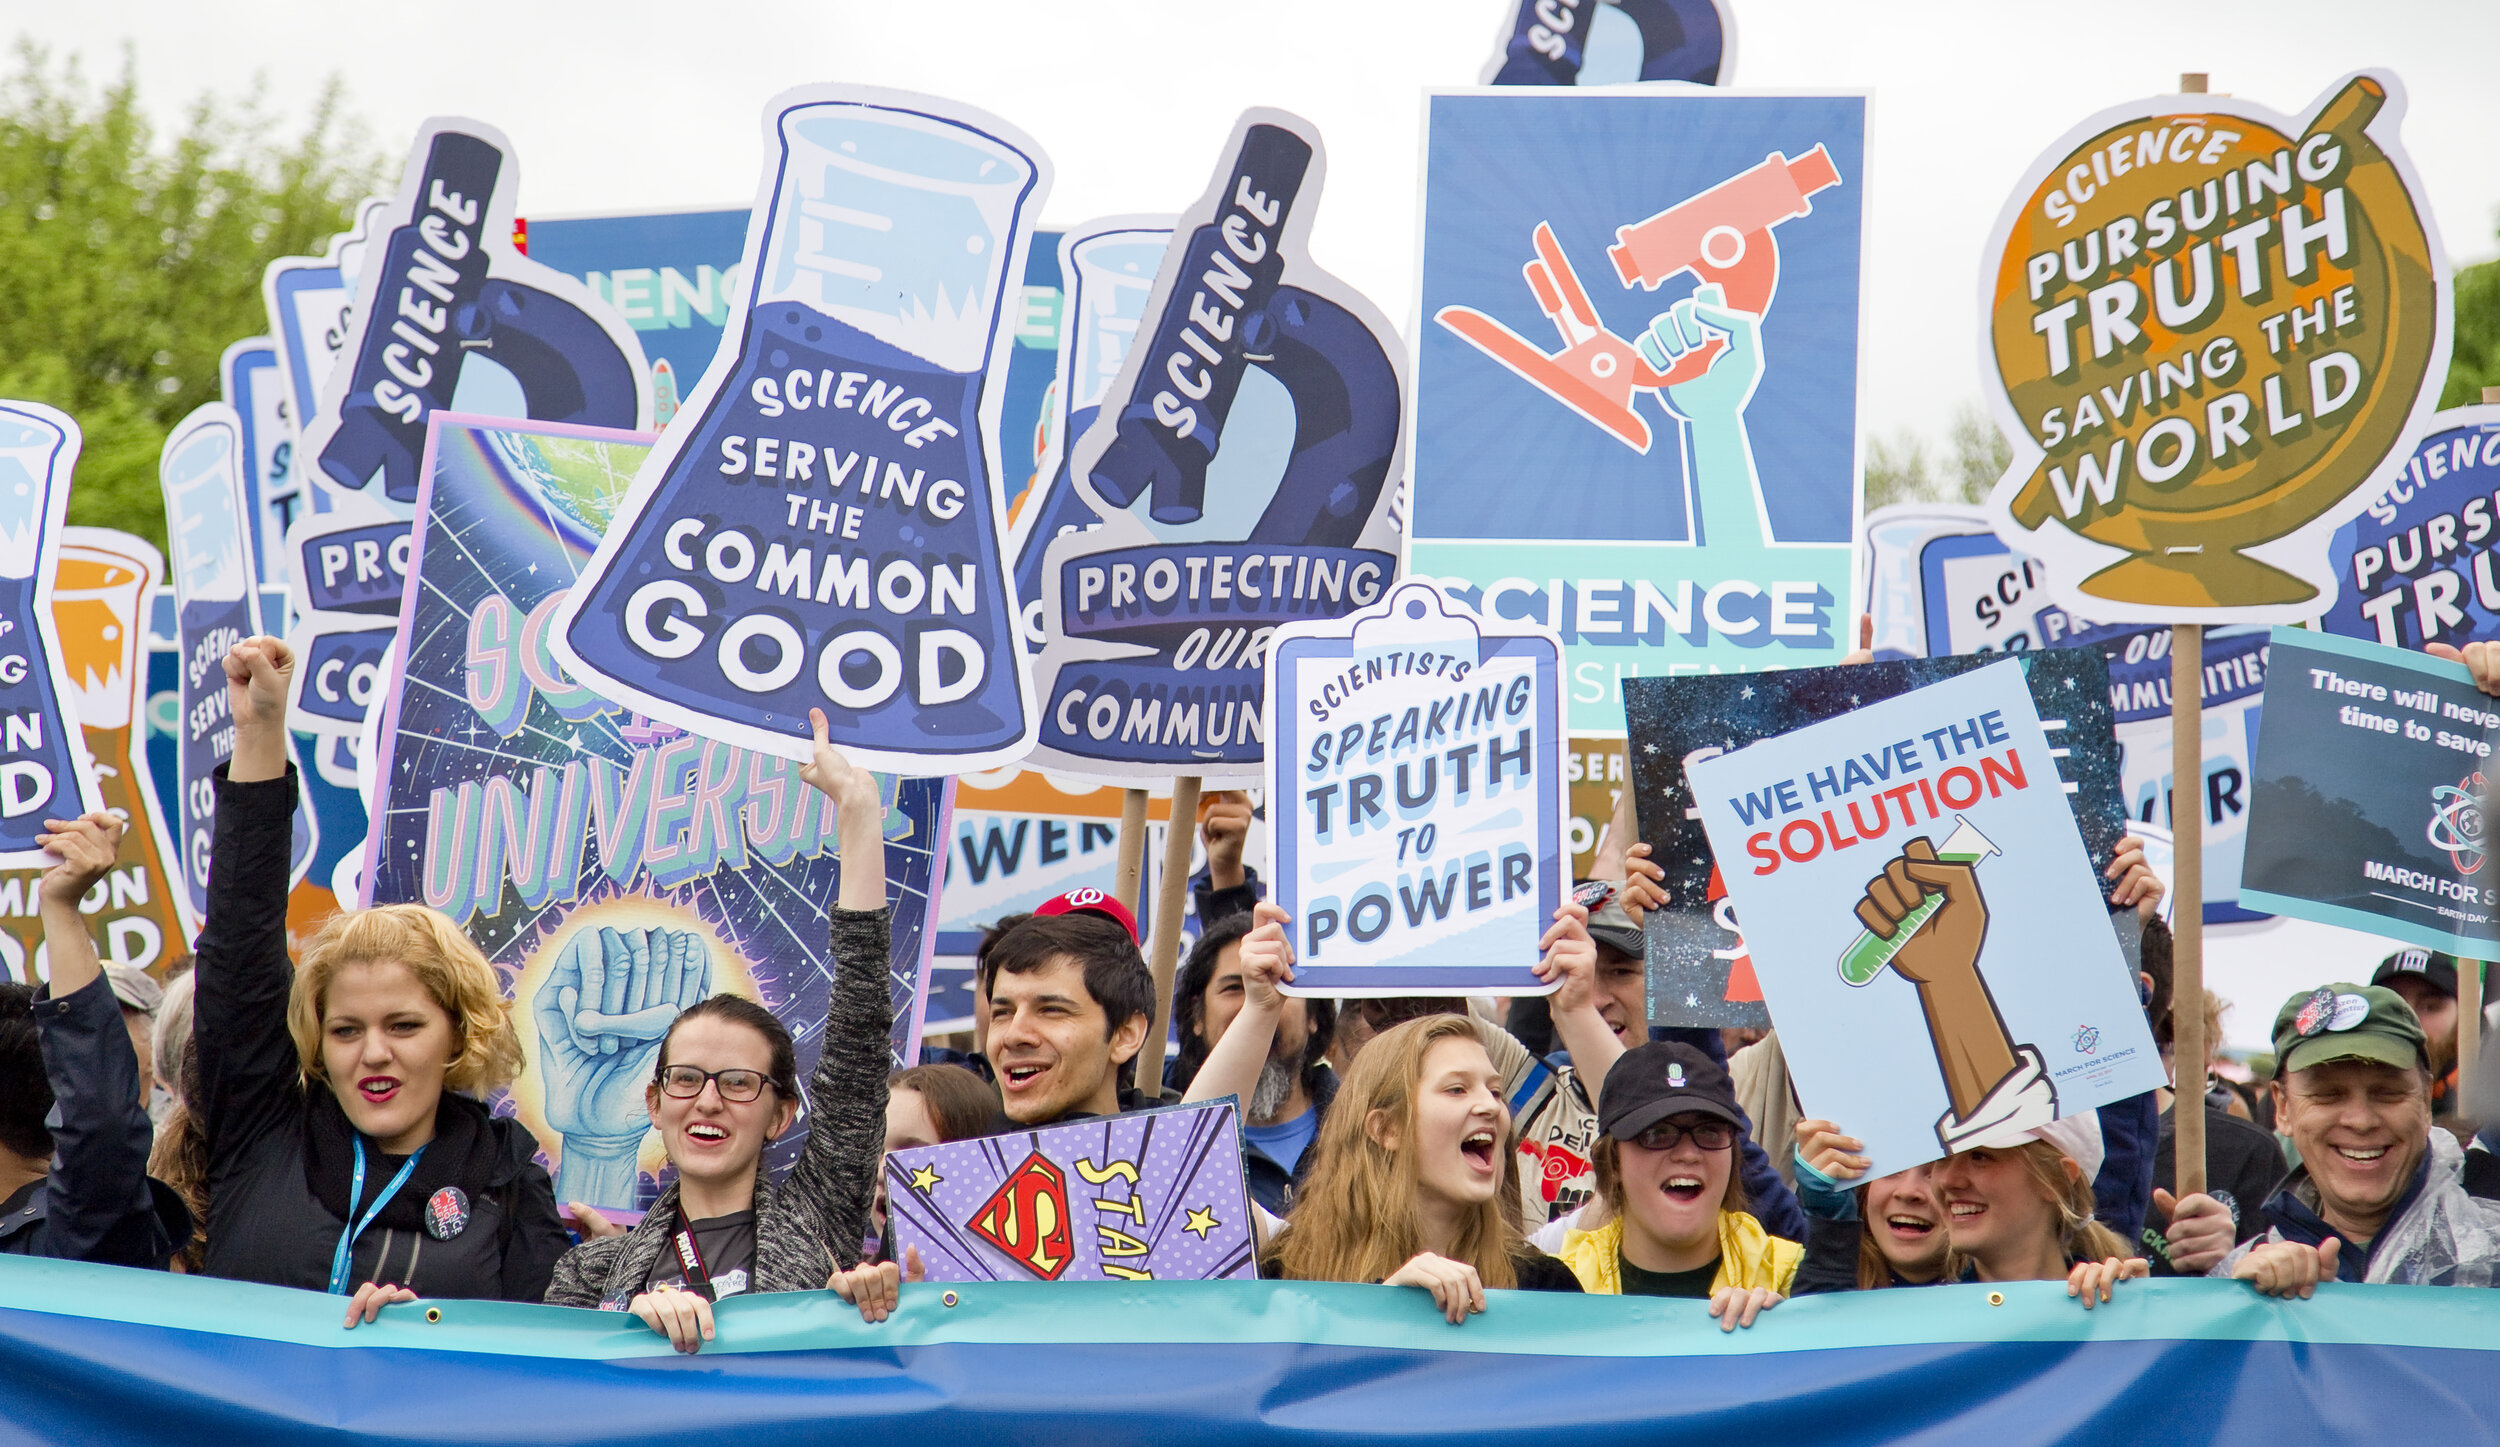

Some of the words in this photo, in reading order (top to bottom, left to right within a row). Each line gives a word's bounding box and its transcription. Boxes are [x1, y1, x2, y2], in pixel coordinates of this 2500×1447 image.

[2027, 132, 2342, 302] PURSUING
[2043, 125, 2242, 228] SCIENCE
[372, 178, 478, 425] SCIENCE
[1153, 175, 1280, 439] SCIENCE
[2033, 187, 2350, 378] TRUTH
[2040, 336, 2238, 448] SAVING
[2260, 285, 2357, 355] THE
[750, 368, 958, 449] SCIENCE
[2047, 350, 2361, 520] WORLD
[719, 435, 966, 520] SERVING
[785, 493, 864, 541] THE
[663, 517, 977, 616] COMMON
[1078, 554, 1383, 613] PROTECTING
[625, 579, 985, 709] GOOD
[1307, 676, 1532, 774] SPEAKING
[1309, 652, 1472, 723] SCIENTISTS
[2309, 668, 2388, 702] There
[2393, 689, 2439, 715] will
[2442, 701, 2500, 730] neve
[1729, 778, 1813, 828] WE
[1805, 737, 1924, 804] HAVE
[1923, 709, 2011, 765] THE
[2339, 705, 2400, 735] time
[2404, 718, 2432, 743] to
[2435, 729, 2492, 759] save
[1306, 727, 1532, 835] TRUTH
[1745, 747, 2030, 877] SOLUTION
[1397, 822, 1436, 861] TO
[2364, 860, 2437, 894] MARCH
[2437, 878, 2479, 904] FOR
[1307, 852, 1533, 957] POWER
[2437, 905, 2467, 921] EARTH
[2467, 912, 2489, 925] DAY
[2297, 991, 2333, 1020] SCIENCE
[2055, 1064, 2084, 1078] MARCH
[2084, 1058, 2102, 1069] FOR
[2102, 1047, 2137, 1063] SCIENCE
[432, 1197, 449, 1239] SILENCE
[442, 1205, 452, 1225] NOT
[445, 1189, 463, 1236] SCIENCE
[675, 1230, 700, 1271] PENTAX
[599, 1301, 625, 1312] SCIENCE
